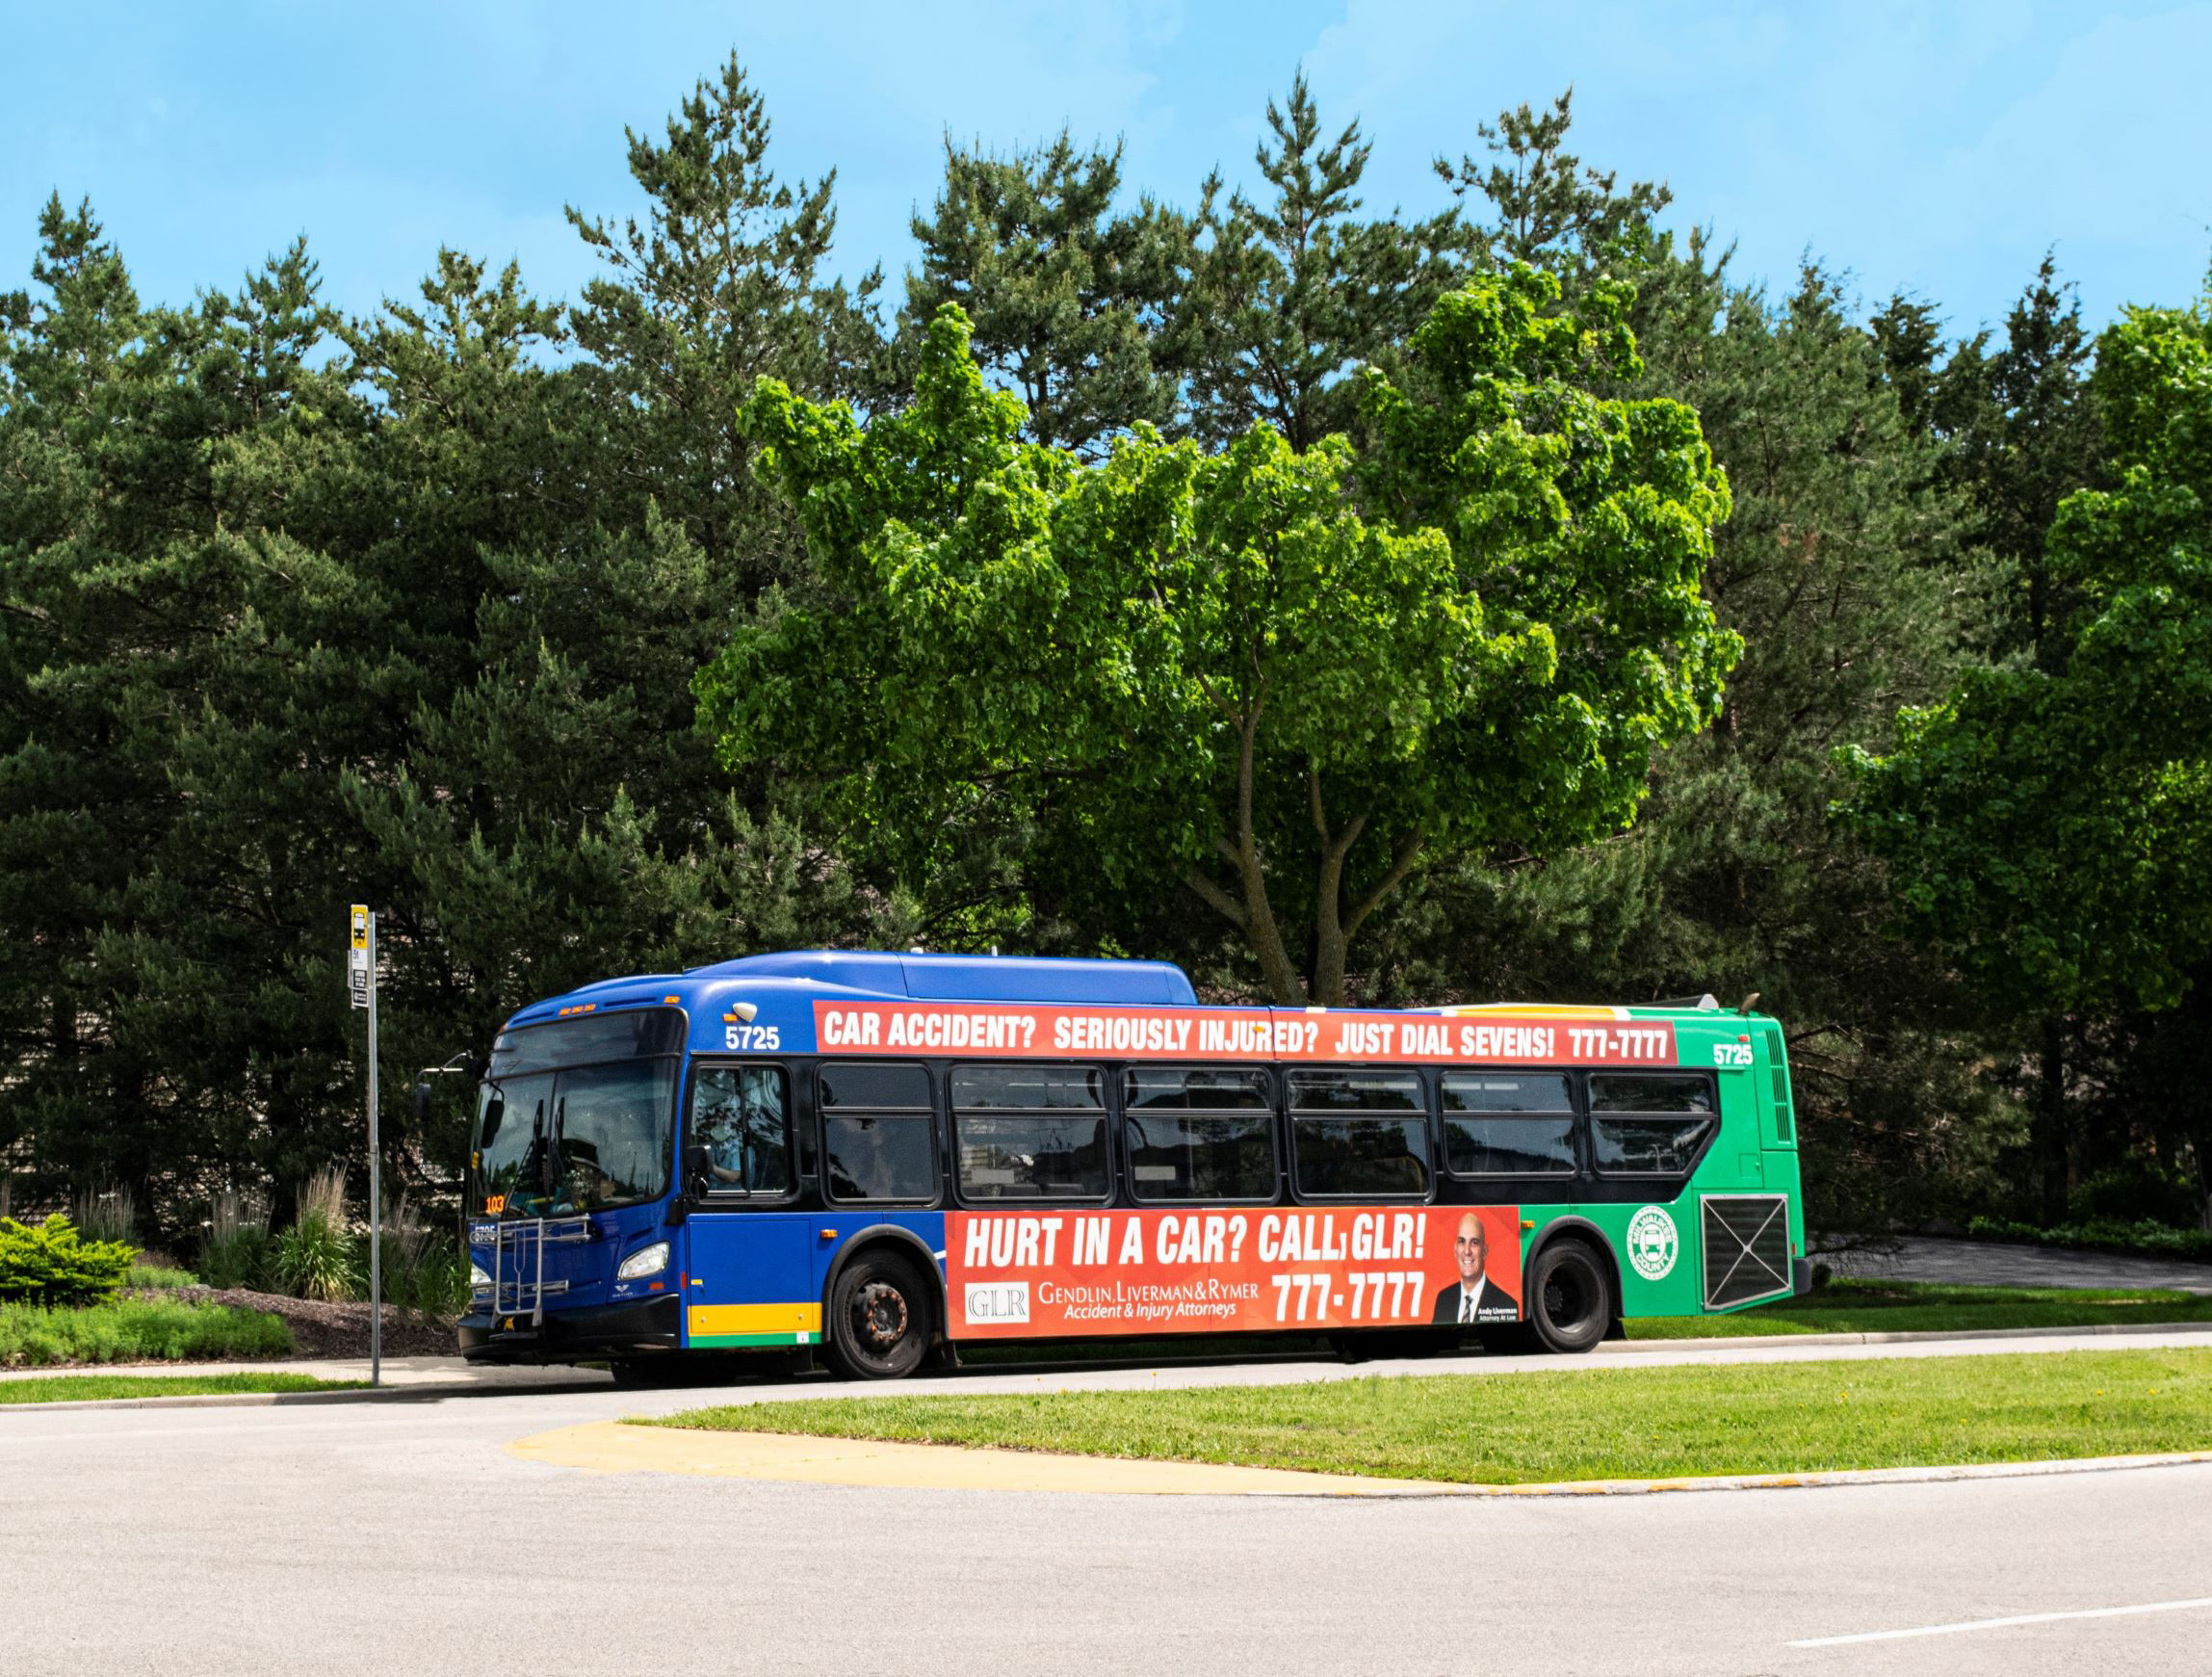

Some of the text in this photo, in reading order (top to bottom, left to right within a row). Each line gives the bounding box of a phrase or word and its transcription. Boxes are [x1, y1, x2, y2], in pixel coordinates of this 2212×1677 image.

[725, 1026, 779, 1051] 5725
[824, 1010, 1669, 1060] CAR ACCIDENT? SERIOUSLY INJURED? JUST DIAL SEVENS! 777-7777
[1713, 1043, 1753, 1065] 5725
[485, 1195, 505, 1214] 103
[964, 1218, 1062, 1268] HURT
[1072, 1217, 1110, 1266] IN
[1118, 1217, 1144, 1265] A
[1156, 1215, 1248, 1265] CAR?
[1632, 1215, 1673, 1245] MILWAUKEE
[1636, 1252, 1670, 1272] COUNTY
[968, 1289, 1027, 1318] GLR
[1271, 1271, 1425, 1323] 777-7777
[1064, 1301, 1236, 1321] Accident & Injury Attorneys
